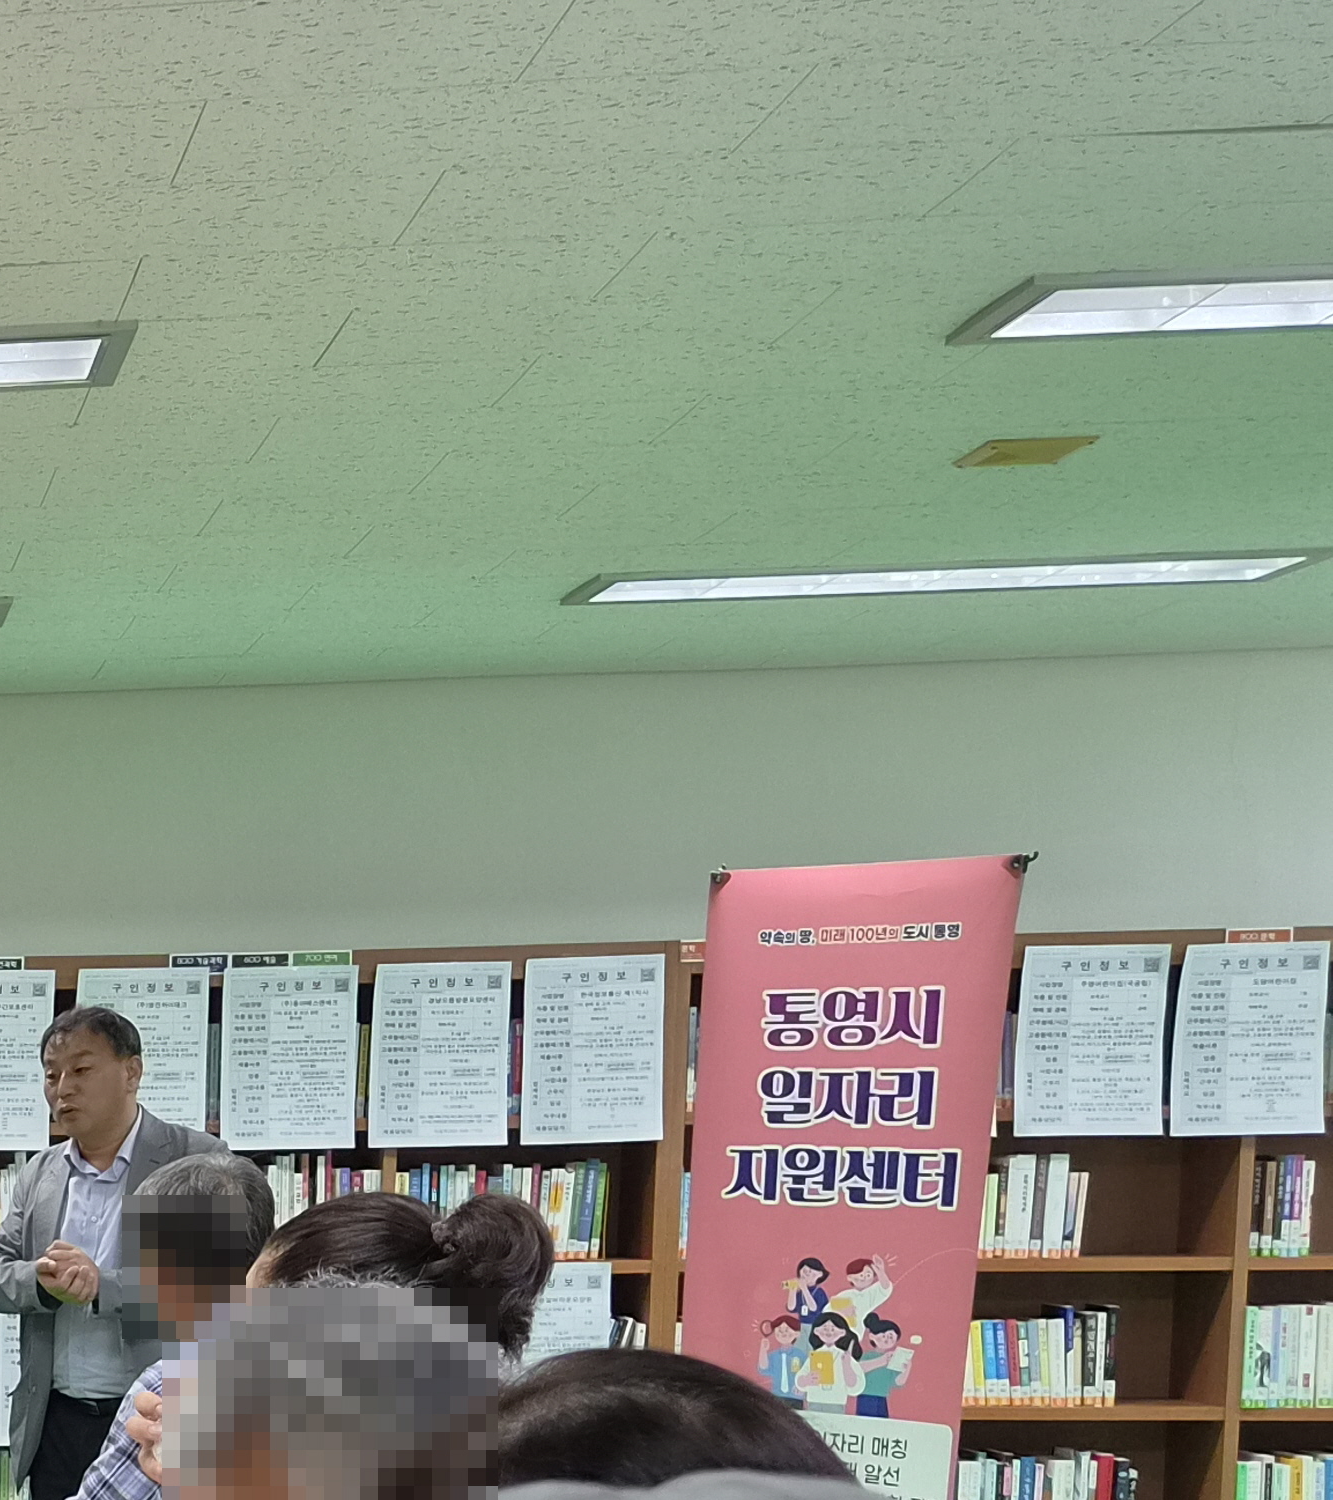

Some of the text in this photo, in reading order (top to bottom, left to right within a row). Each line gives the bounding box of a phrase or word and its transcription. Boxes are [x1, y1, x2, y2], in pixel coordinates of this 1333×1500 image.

[760, 922, 961, 945] 약속의 땅, 미래 100년의 도시 통영
[764, 989, 942, 1047] 통영시
[760, 1069, 935, 1126] 일자리
[724, 1147, 959, 1208] 지원센터
[871, 1437, 908, 1459] 매칭
[864, 1464, 901, 1487] 알선
